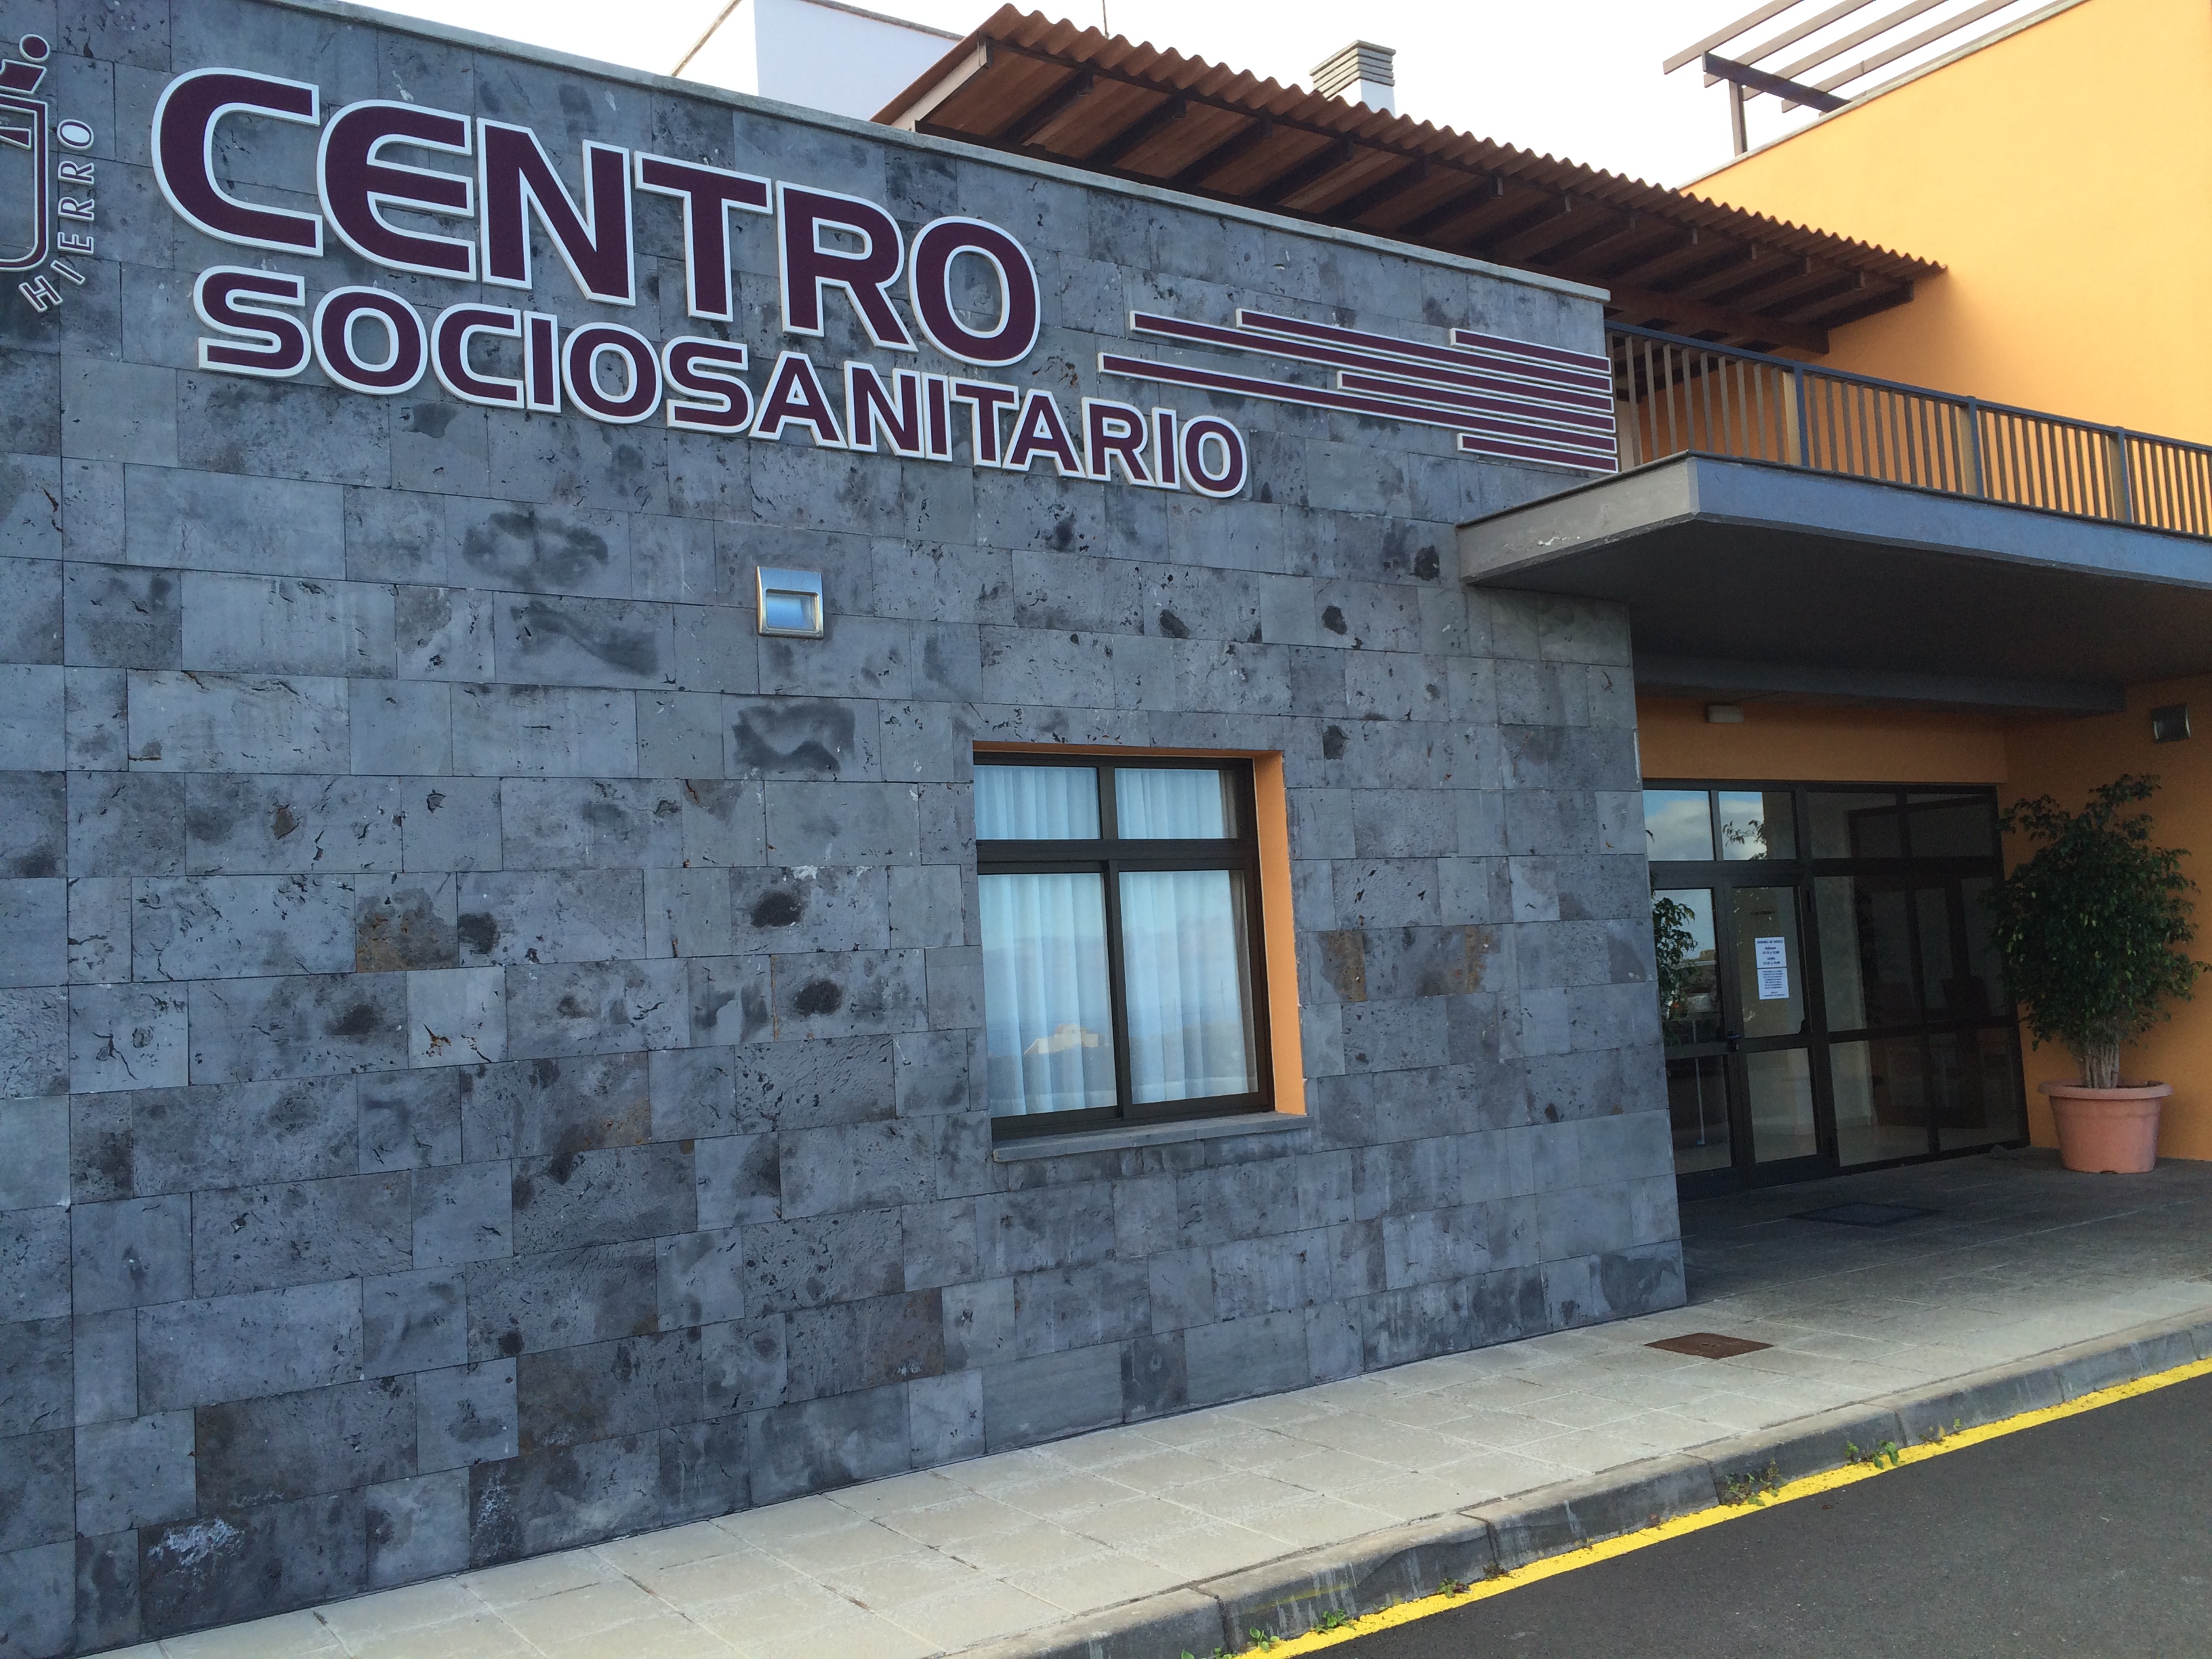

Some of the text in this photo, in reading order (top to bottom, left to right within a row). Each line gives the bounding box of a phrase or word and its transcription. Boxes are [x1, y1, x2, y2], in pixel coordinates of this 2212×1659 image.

[19, 119, 94, 313] HIERRO
[151, 66, 1042, 367] CENTRO
[193, 265, 1248, 498] SOCIOSANITARIO
